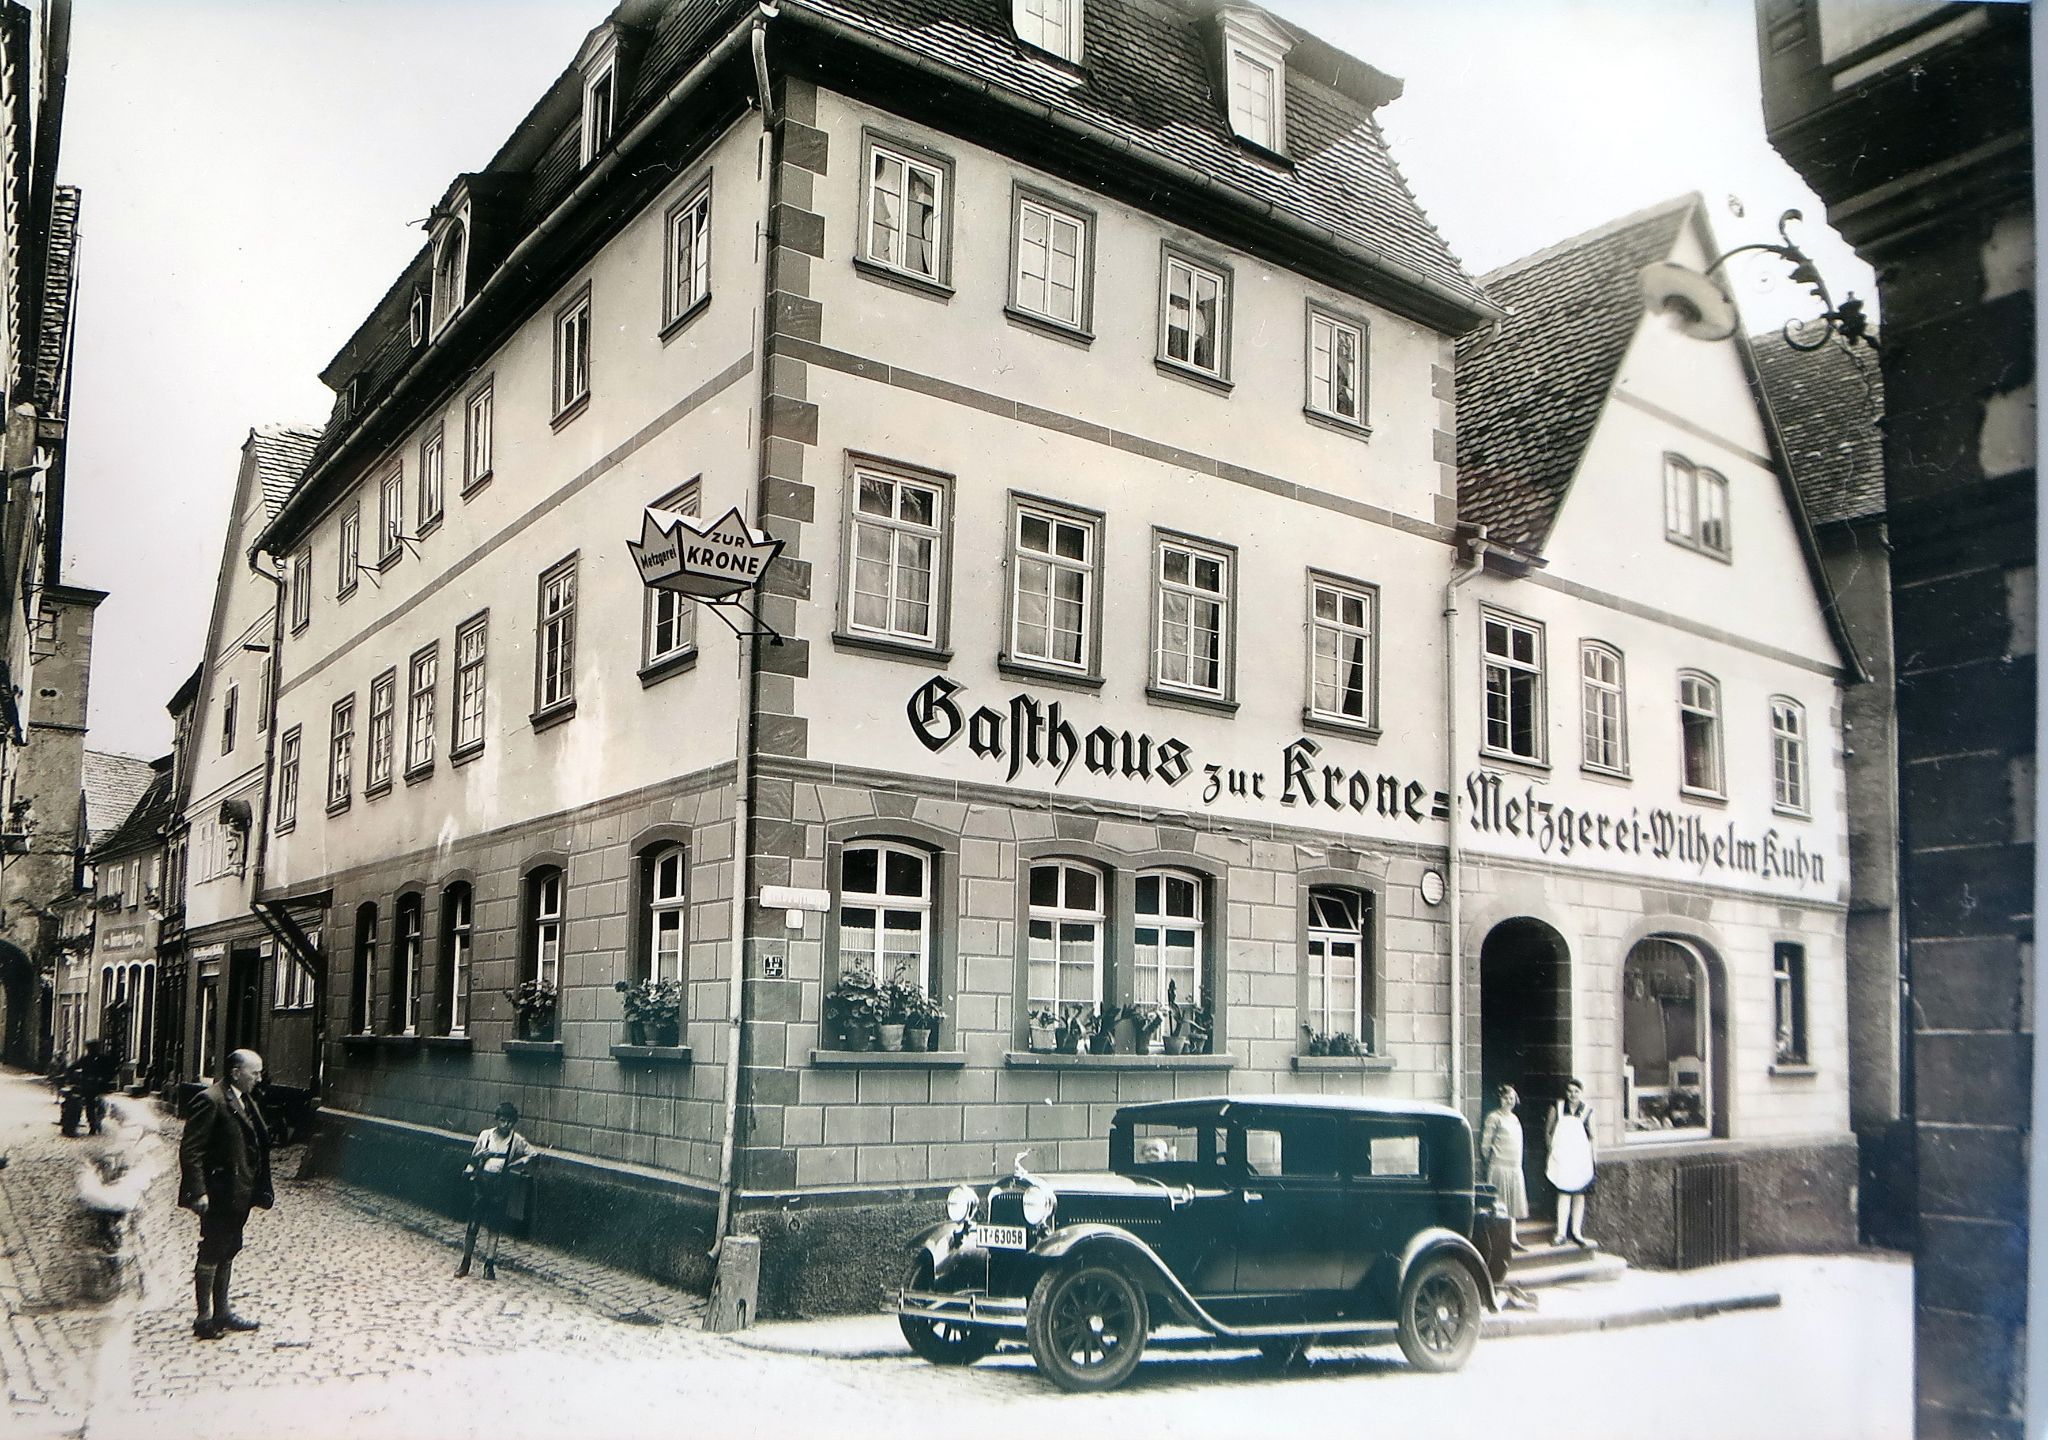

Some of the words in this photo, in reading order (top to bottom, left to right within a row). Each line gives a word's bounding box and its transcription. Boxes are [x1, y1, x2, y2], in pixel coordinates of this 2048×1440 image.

[711, 532, 745, 548] ZUR
[640, 544, 677, 570] Metzgerei
[686, 545, 760, 575] KRONE
[1203, 762, 1266, 805] zur
[1762, 828, 1825, 889] Kuhn
